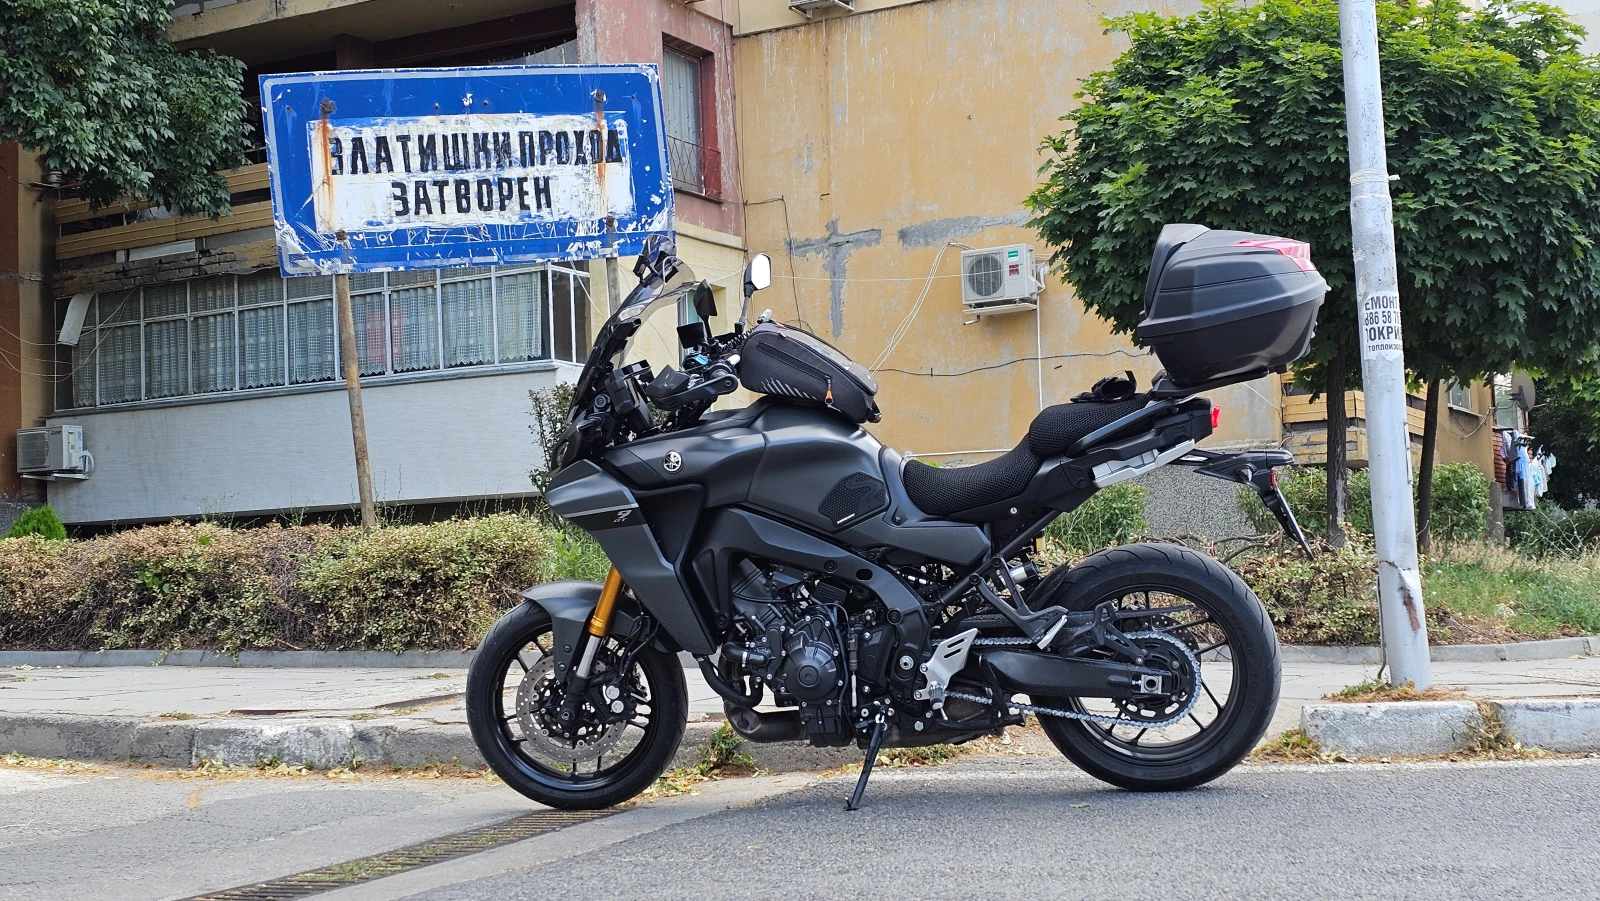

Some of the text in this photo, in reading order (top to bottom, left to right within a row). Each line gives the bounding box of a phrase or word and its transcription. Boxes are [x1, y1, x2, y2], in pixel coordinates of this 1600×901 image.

[328, 129, 623, 175] ЗЛАТИШКИ ПРОХОД
[391, 177, 552, 216] ЗАТВОРЕН
[1382, 311, 1392, 324] 58
[617, 510, 632, 518] 9
